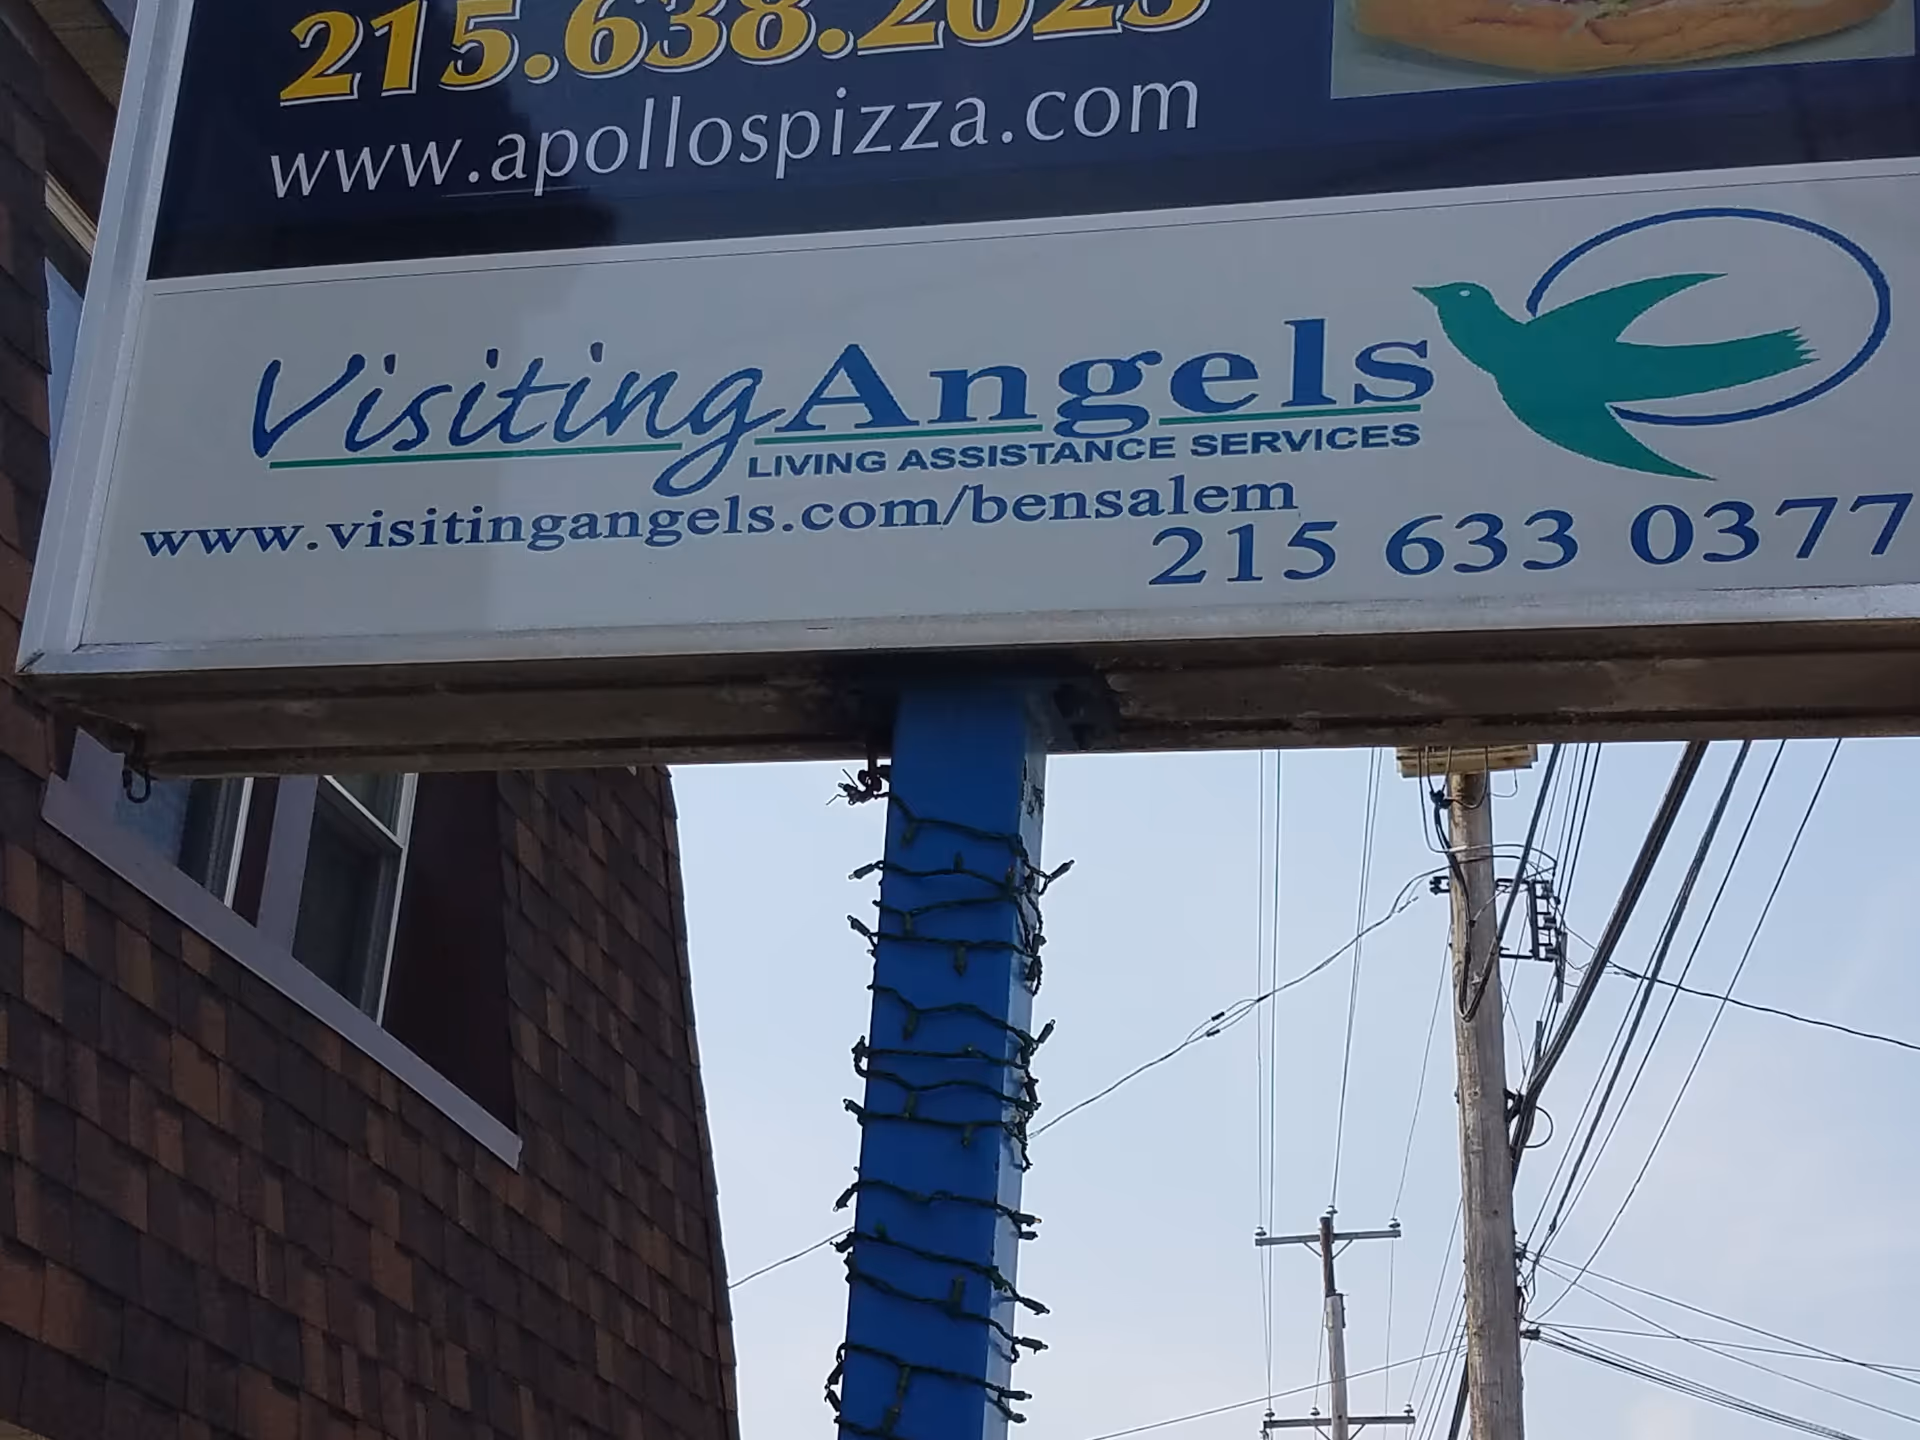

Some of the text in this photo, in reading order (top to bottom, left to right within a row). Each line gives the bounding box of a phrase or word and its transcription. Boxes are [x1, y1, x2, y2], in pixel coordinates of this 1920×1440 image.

[270, 77, 1199, 200] www.apollospizza.com
[251, 318, 1434, 498] Visiting Angels
[747, 422, 1421, 479] LIVING ASSISTANCE SERVICES
[141, 474, 1299, 558] www.visitingangels.com/bensalem
[1148, 493, 1914, 586] 215 633 0377
